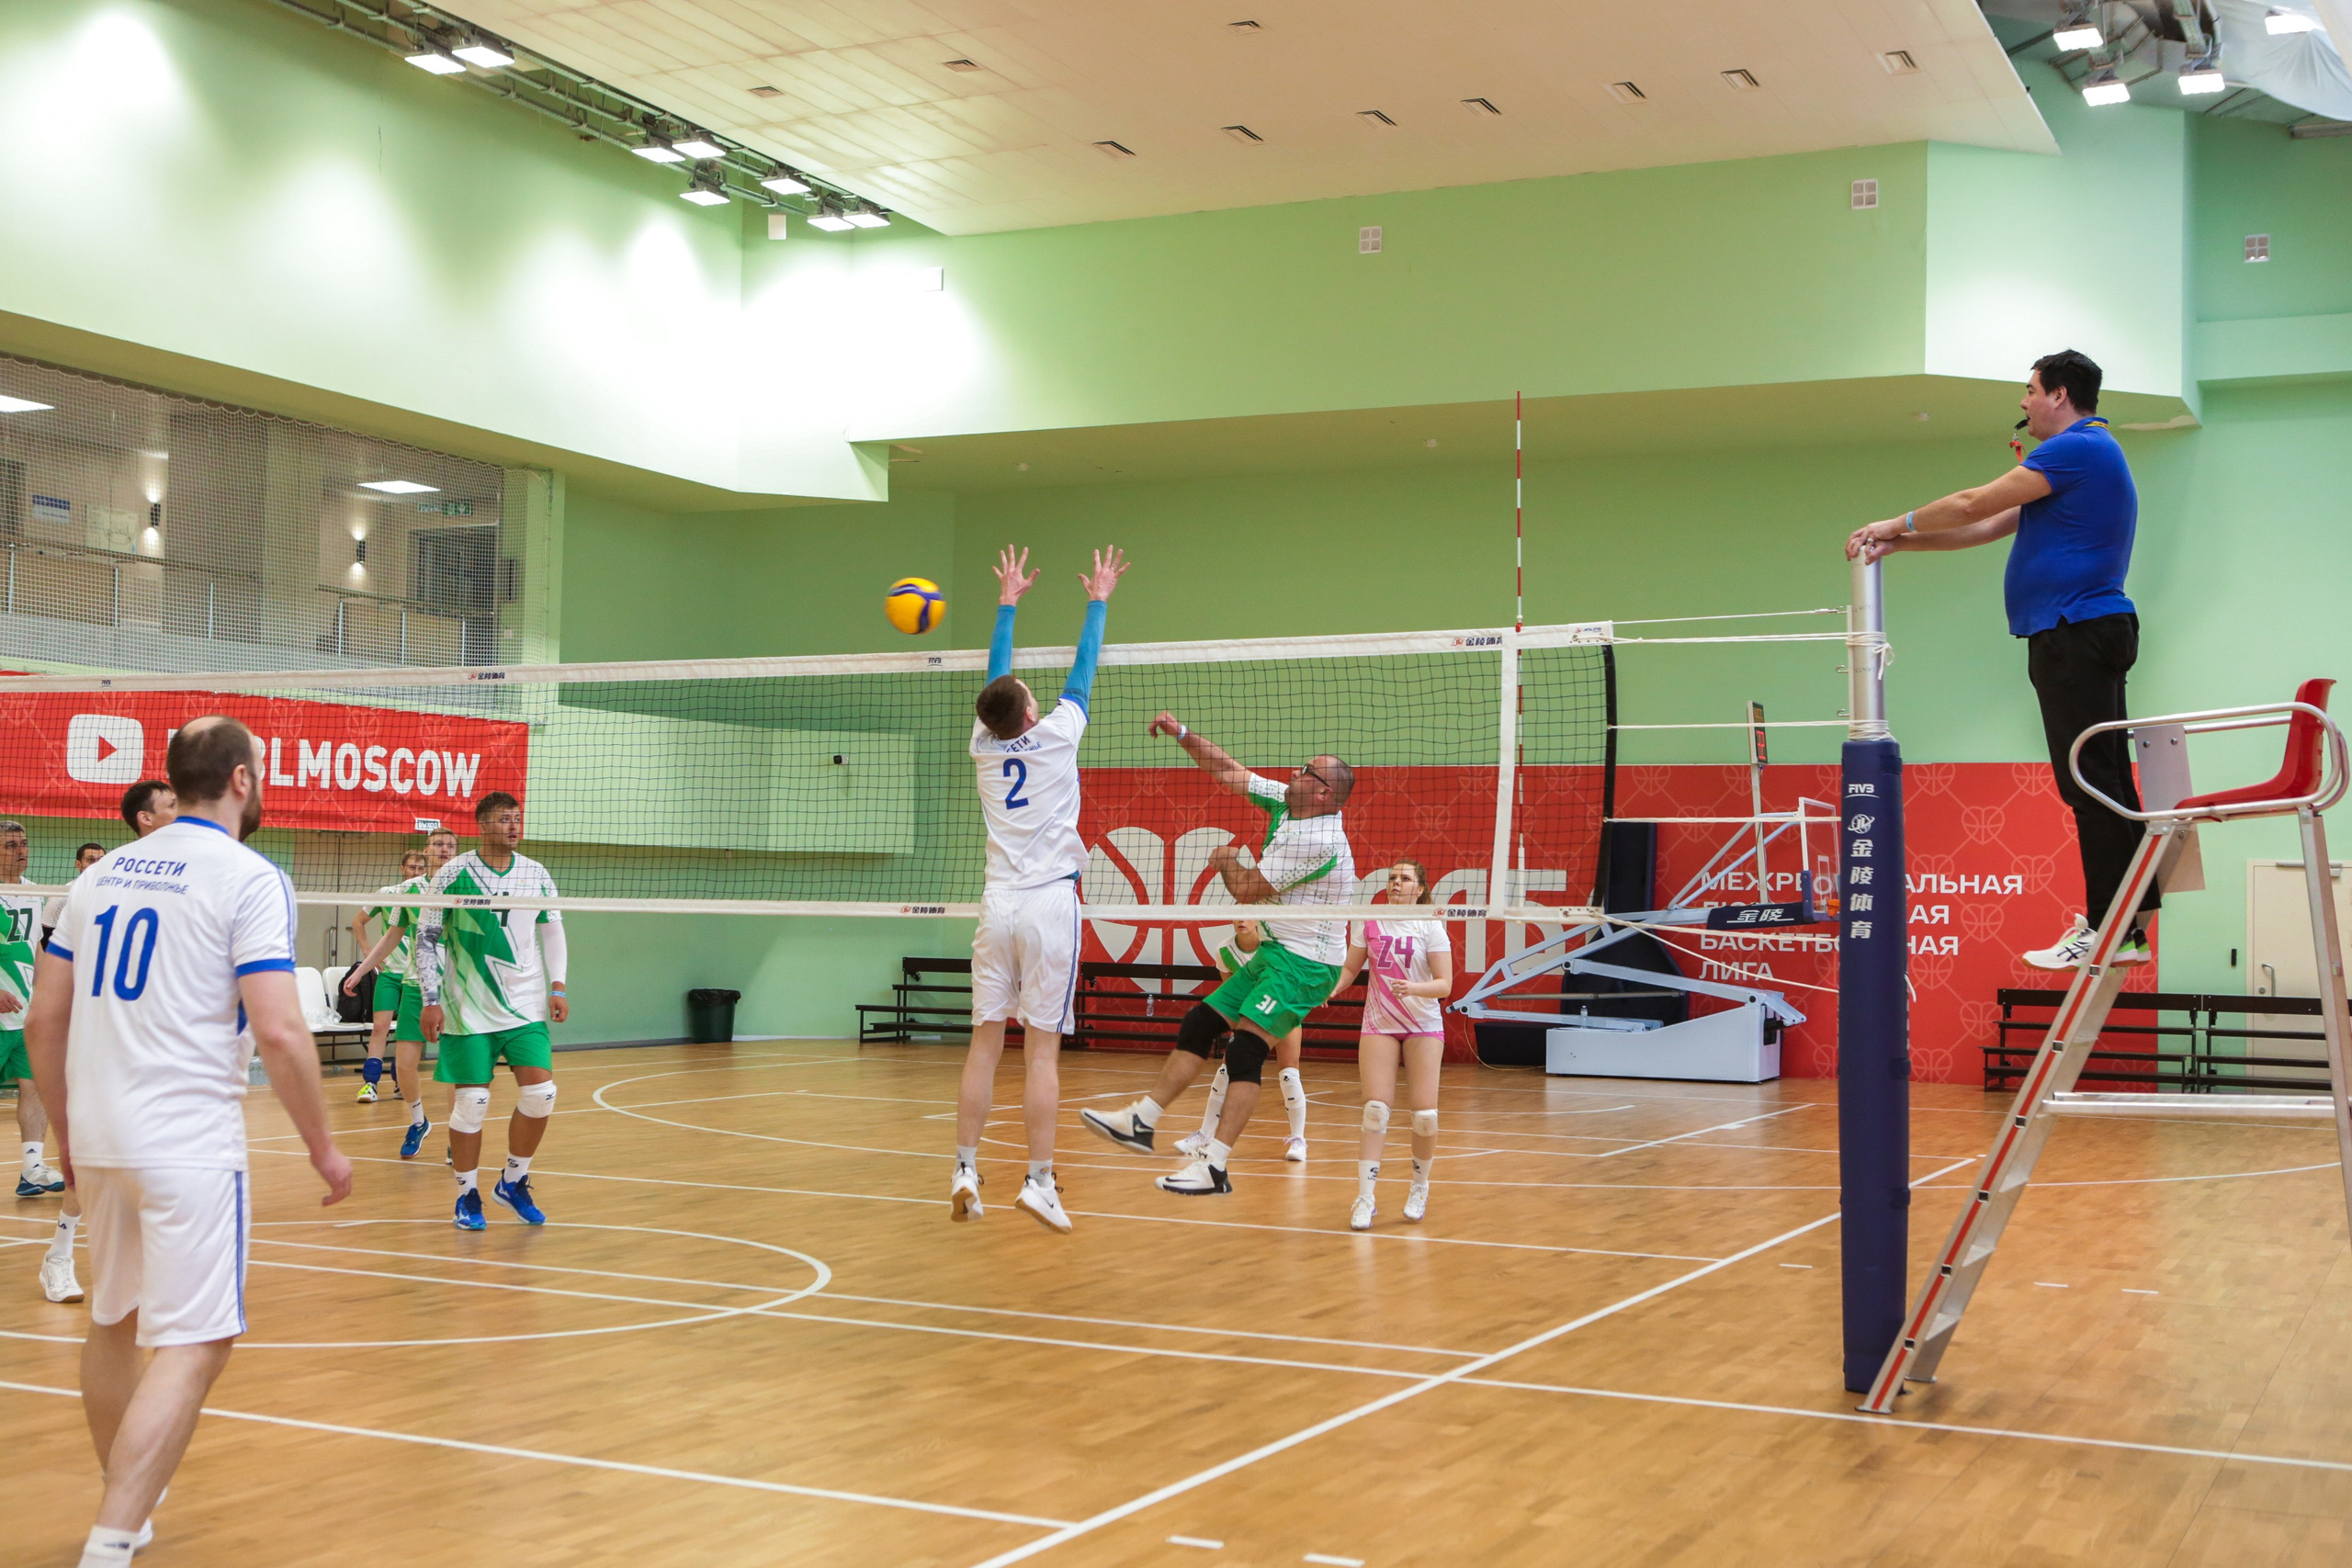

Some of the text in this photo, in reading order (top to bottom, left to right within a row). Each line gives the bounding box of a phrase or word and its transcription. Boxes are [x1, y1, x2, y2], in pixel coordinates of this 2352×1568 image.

[168, 728, 481, 798] LMOSCOW
[1002, 758, 1029, 810] 2
[112, 856, 188, 876] РОССЕТИ
[123, 879, 132, 888] И
[1849, 839, 1874, 939] 金陵体育
[6, 908, 33, 942] 27
[91, 905, 159, 1001] 10
[1377, 935, 1415, 969] 24
[1699, 961, 1774, 981] ЛИГА
[1255, 994, 1277, 1015] 31
